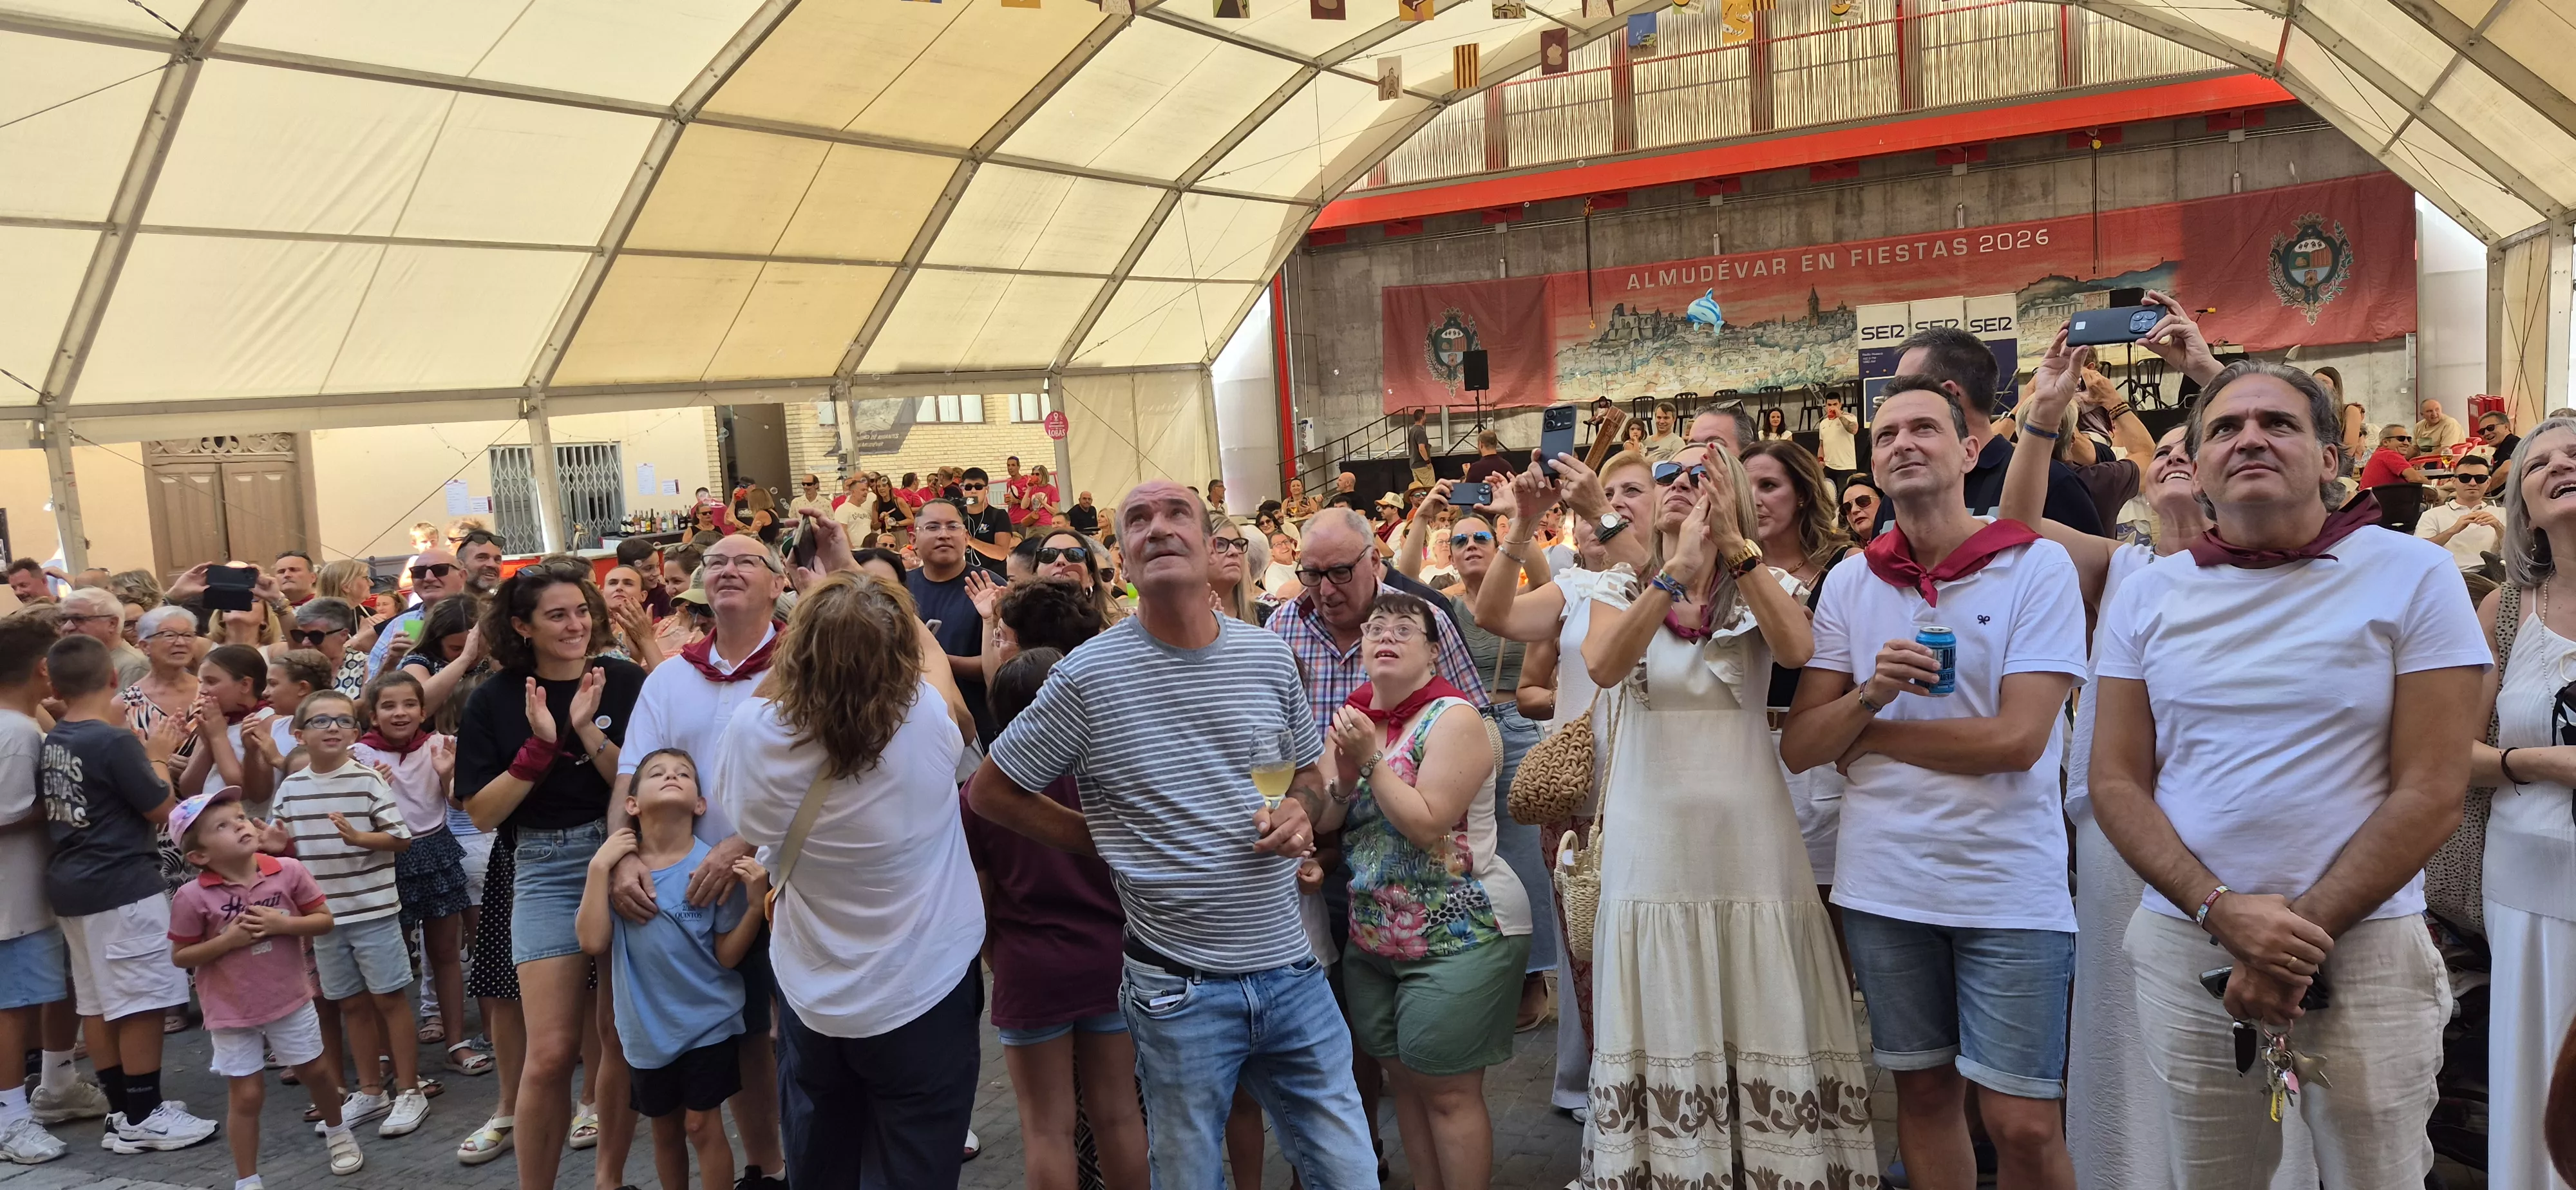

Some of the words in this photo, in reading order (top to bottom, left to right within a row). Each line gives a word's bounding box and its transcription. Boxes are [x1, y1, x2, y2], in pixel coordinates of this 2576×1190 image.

[1627, 258, 1786, 290] ALMUDÉVAR
[1801, 252, 1835, 272] EN
[1850, 238, 1968, 267] FIESTAS
[1979, 229, 2049, 252] 2026
[1861, 324, 1906, 341] SER
[1969, 316, 2012, 333] SER
